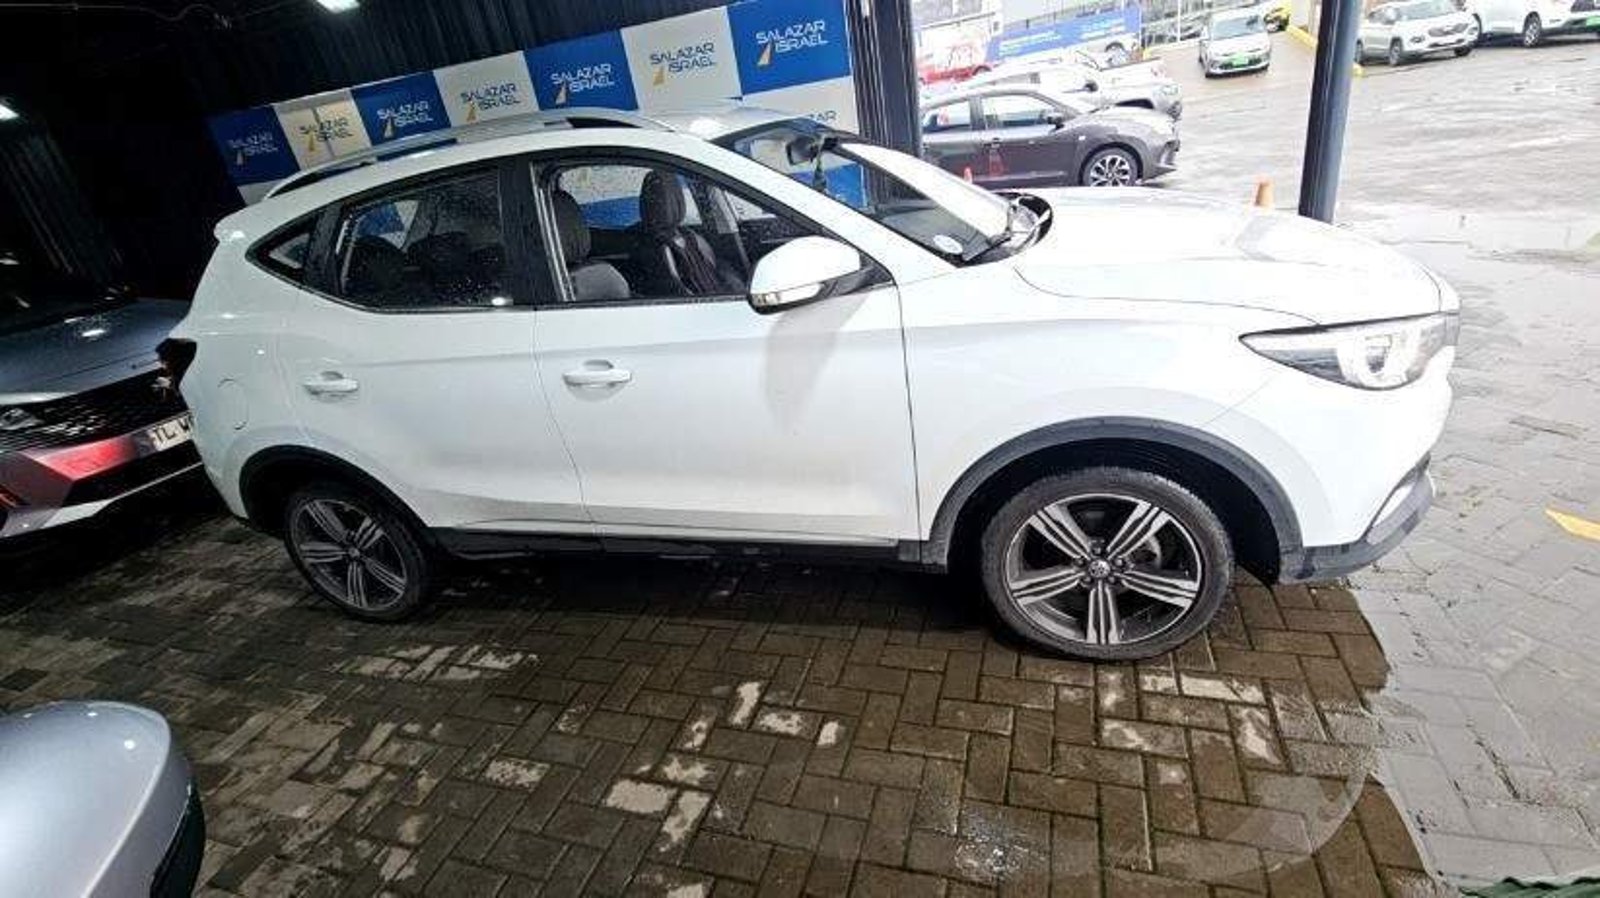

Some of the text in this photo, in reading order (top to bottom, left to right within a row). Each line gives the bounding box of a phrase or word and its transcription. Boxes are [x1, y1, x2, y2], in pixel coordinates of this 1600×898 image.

[755, 20, 825, 44] SALAZAR
[775, 33, 828, 53] ISRAEL
[650, 42, 714, 65] SALAZAR
[669, 55, 717, 73] ISRAEL
[551, 63, 612, 85] SALAZAR
[460, 82, 517, 103] SALAZAR
[569, 75, 615, 93] ISRAEL
[377, 101, 429, 120] SALAZAR
[479, 95, 520, 111] ISRAEL
[395, 112, 433, 127] ISRAEL
